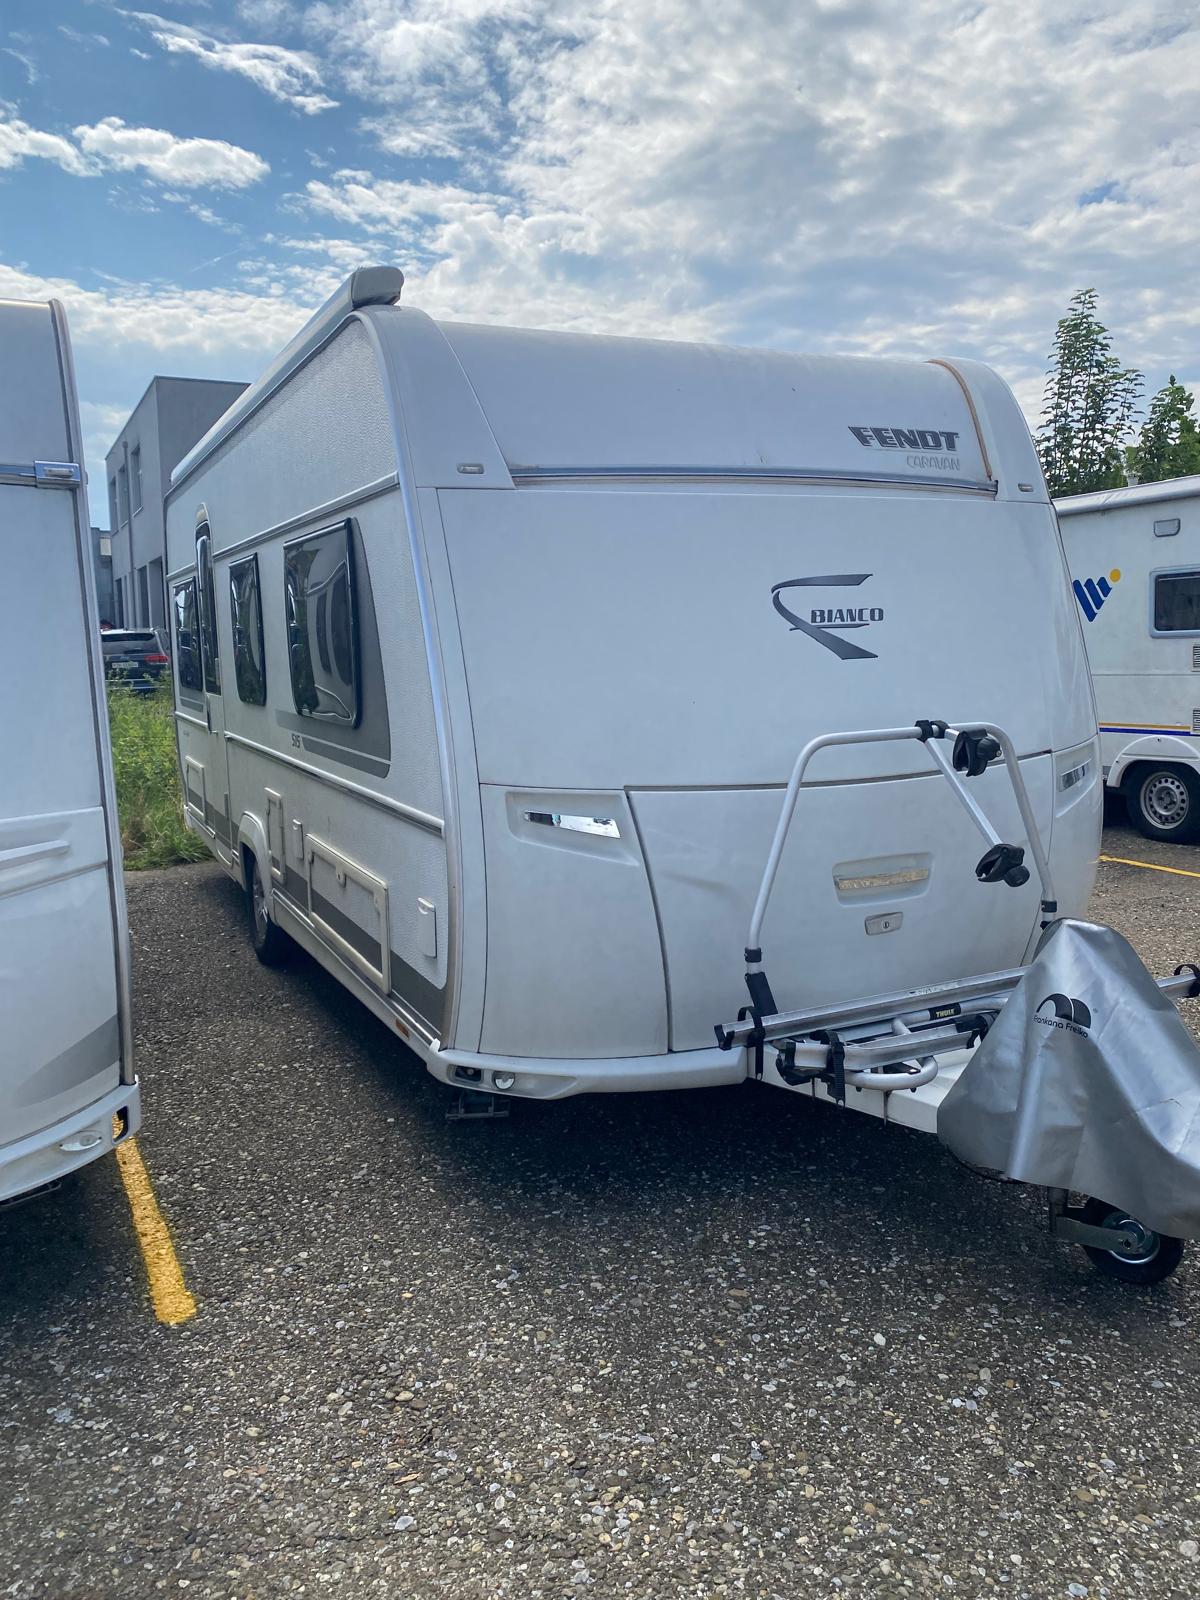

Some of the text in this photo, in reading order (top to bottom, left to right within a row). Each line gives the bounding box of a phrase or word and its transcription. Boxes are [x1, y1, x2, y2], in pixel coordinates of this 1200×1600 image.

[848, 426, 960, 451] FENDT
[906, 455, 960, 471] CARAVAN
[811, 608, 884, 624] BIANCO
[935, 1008, 955, 1018] THULE
